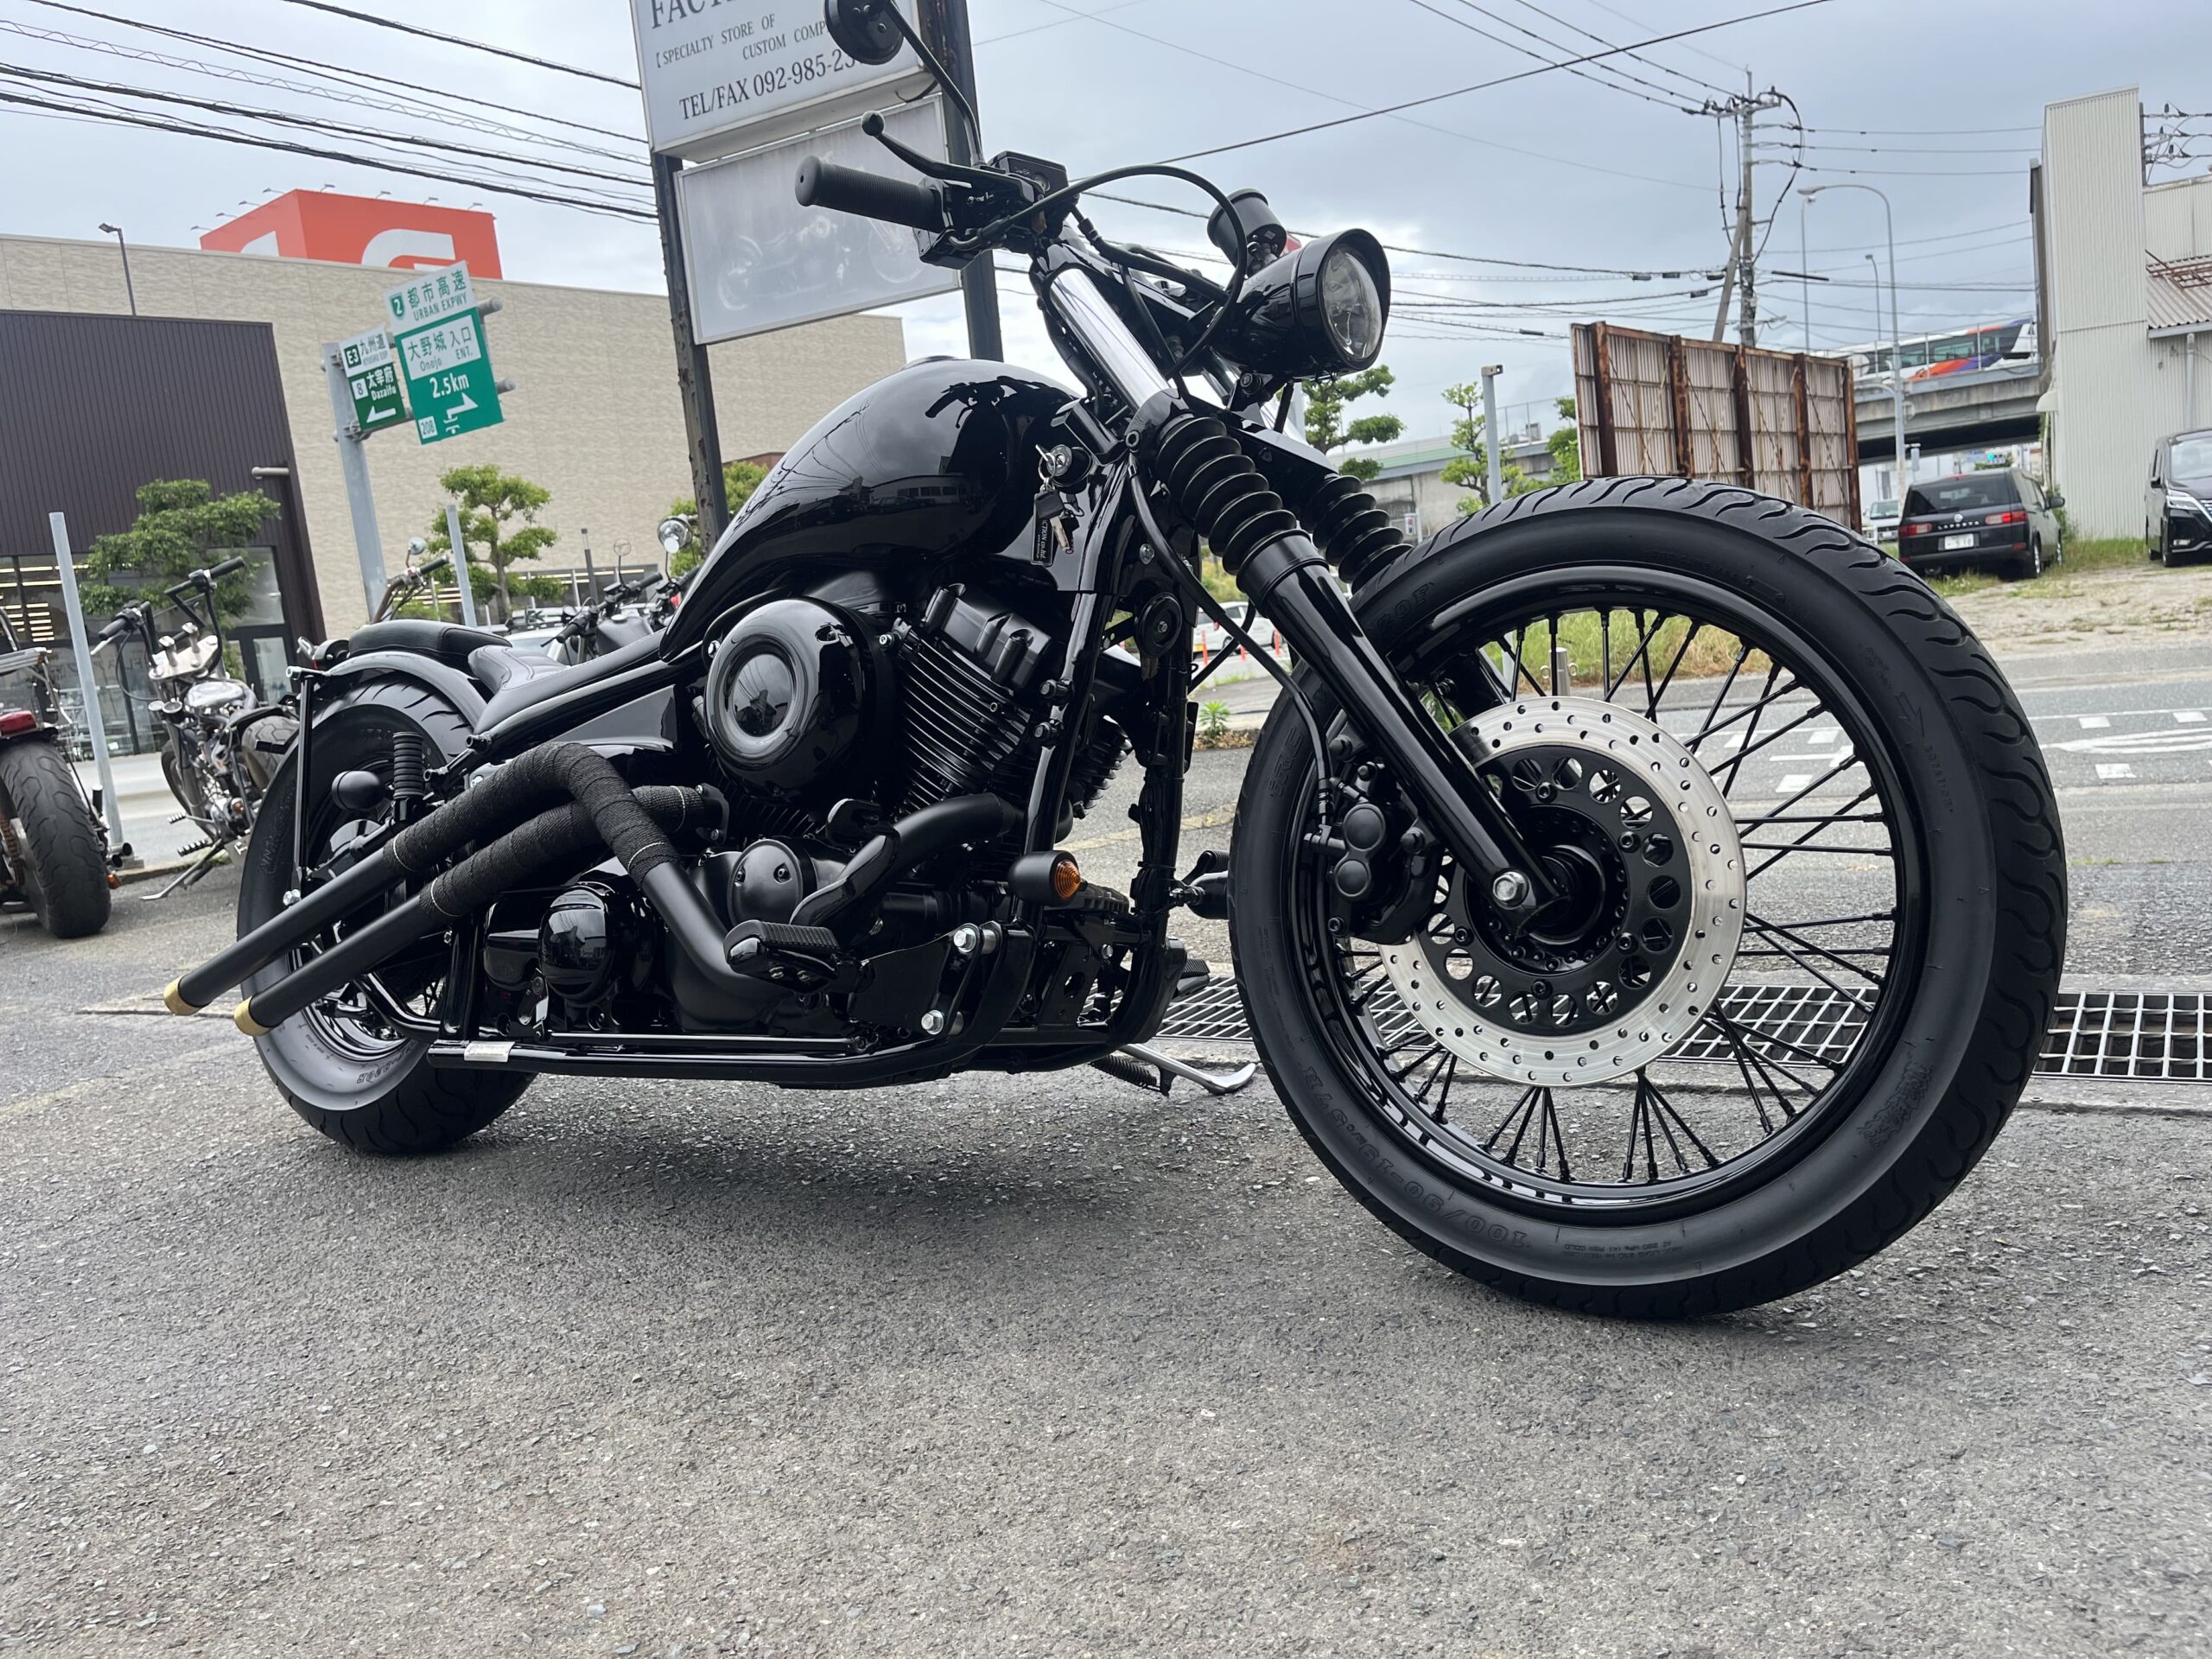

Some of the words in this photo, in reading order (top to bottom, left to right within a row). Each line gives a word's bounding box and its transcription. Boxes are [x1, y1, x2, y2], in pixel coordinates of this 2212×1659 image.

[721, 21, 754, 44] STORE
[761, 14, 775, 31] OF
[742, 34, 786, 60] CUSTOM
[793, 20, 830, 43] COMP
[679, 78, 750, 120] TEL/FAX
[407, 269, 467, 309] 都市高速
[393, 298, 403, 315] 2
[413, 302, 439, 321] URBAN
[441, 291, 467, 311] EXPWY
[346, 348, 359, 365] E3
[359, 334, 386, 355] 九州道
[420, 356, 442, 372] Onojo
[455, 346, 474, 359] ENT.
[356, 382, 364, 396] 8
[366, 365, 394, 390] 太宰府
[429, 372, 469, 398] 2.5km
[371, 384, 397, 401] Dazaifu
